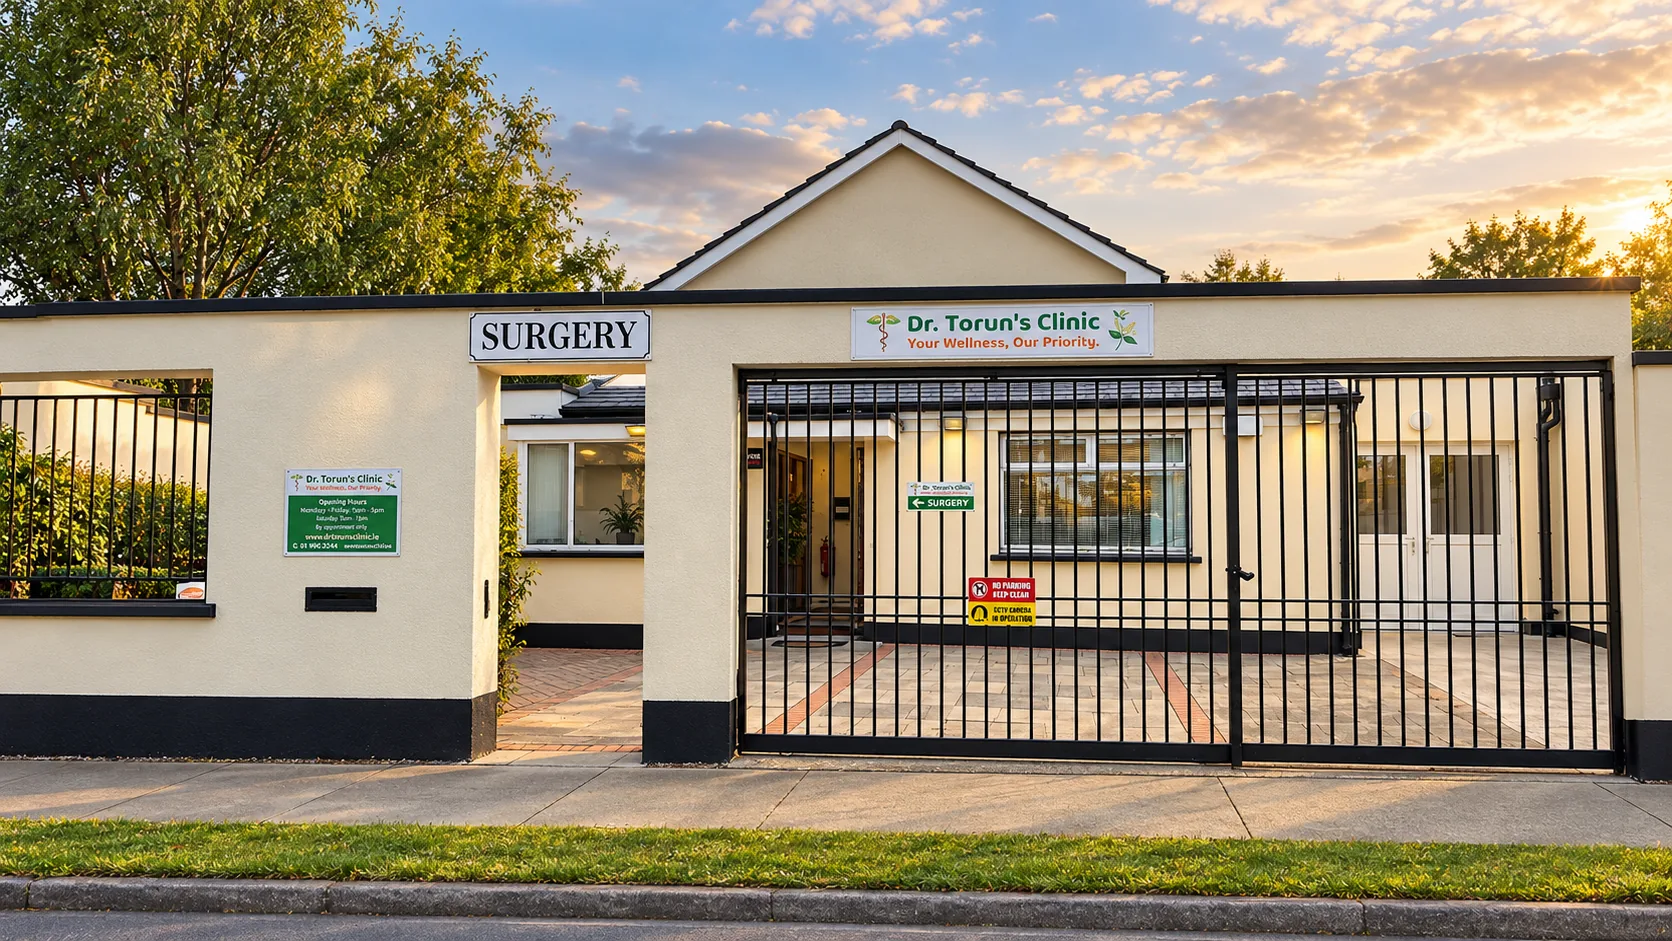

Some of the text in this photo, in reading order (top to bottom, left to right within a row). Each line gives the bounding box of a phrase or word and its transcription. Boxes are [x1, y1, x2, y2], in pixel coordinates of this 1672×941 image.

[907, 311, 1100, 332] Dr. Torun's Clinic
[482, 320, 637, 350] SURGERY
[907, 336, 1100, 351] Your Wellness, Our Priority.
[306, 474, 383, 483] Dr. Torun's Clinic
[927, 499, 969, 507] SURGERY
[1002, 582, 1031, 590] PARKING
[1010, 591, 1030, 599] CLEAR
